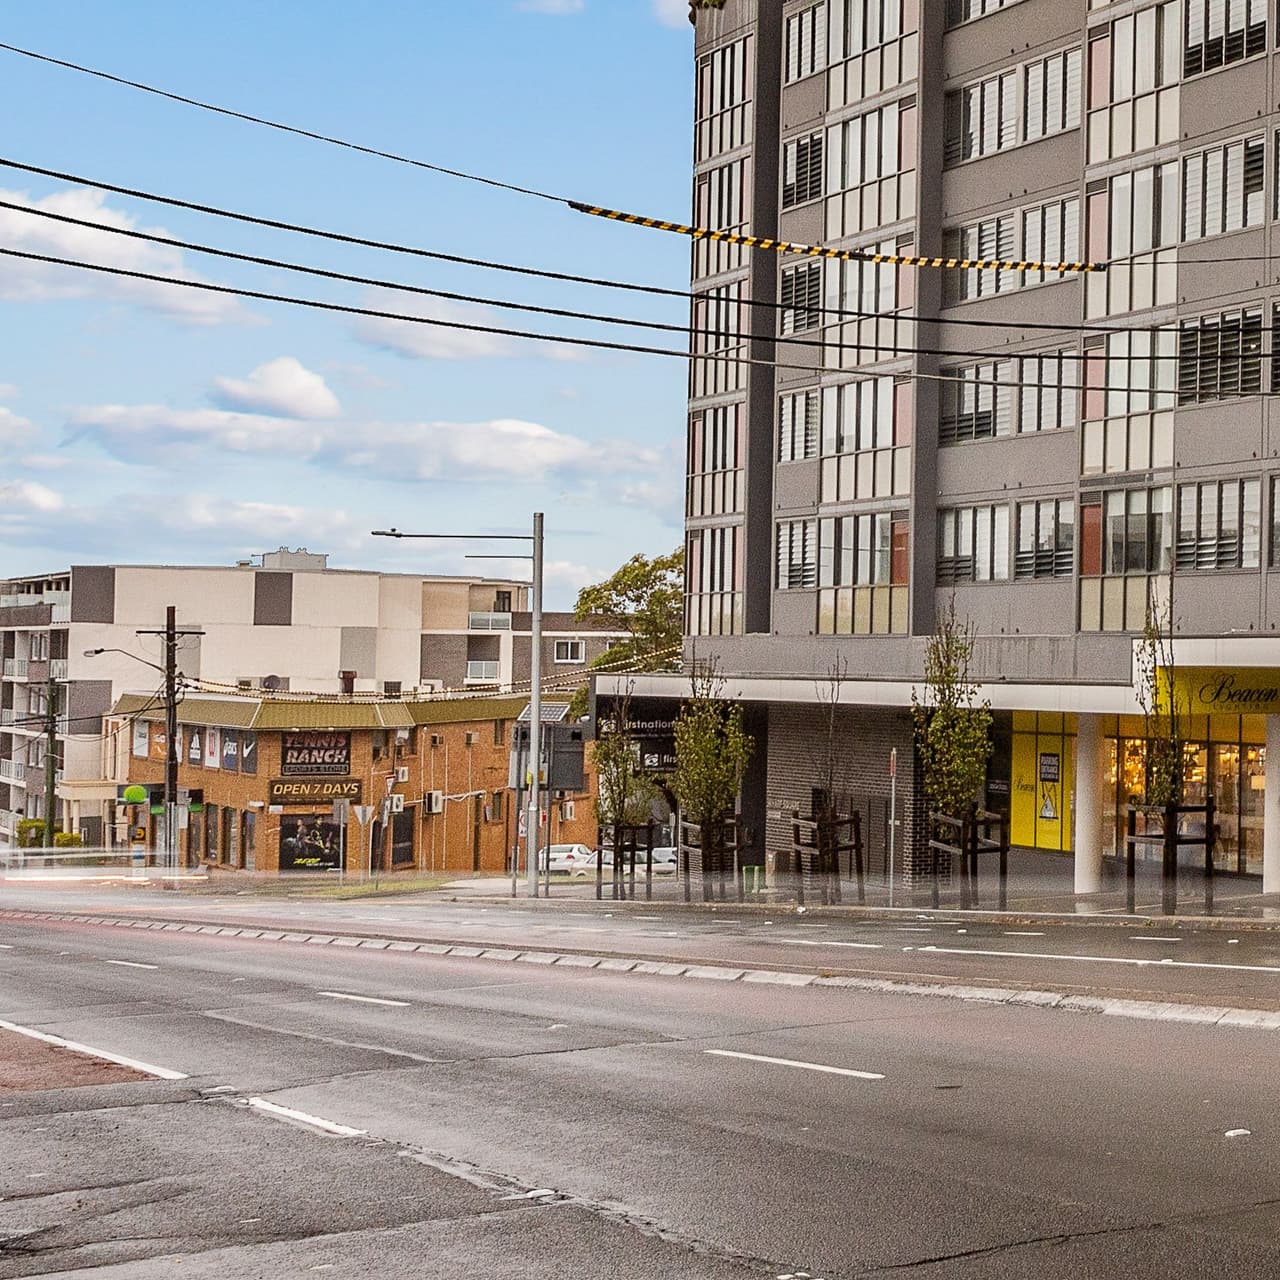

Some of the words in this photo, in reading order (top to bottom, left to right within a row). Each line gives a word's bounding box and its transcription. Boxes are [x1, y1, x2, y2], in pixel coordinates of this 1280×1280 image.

[1199, 672, 1279, 705] Beacon
[286, 733, 346, 747] TENNIS
[273, 784, 310, 795] OPEN
[313, 784, 321, 794] 7
[323, 783, 358, 794] DAYS
